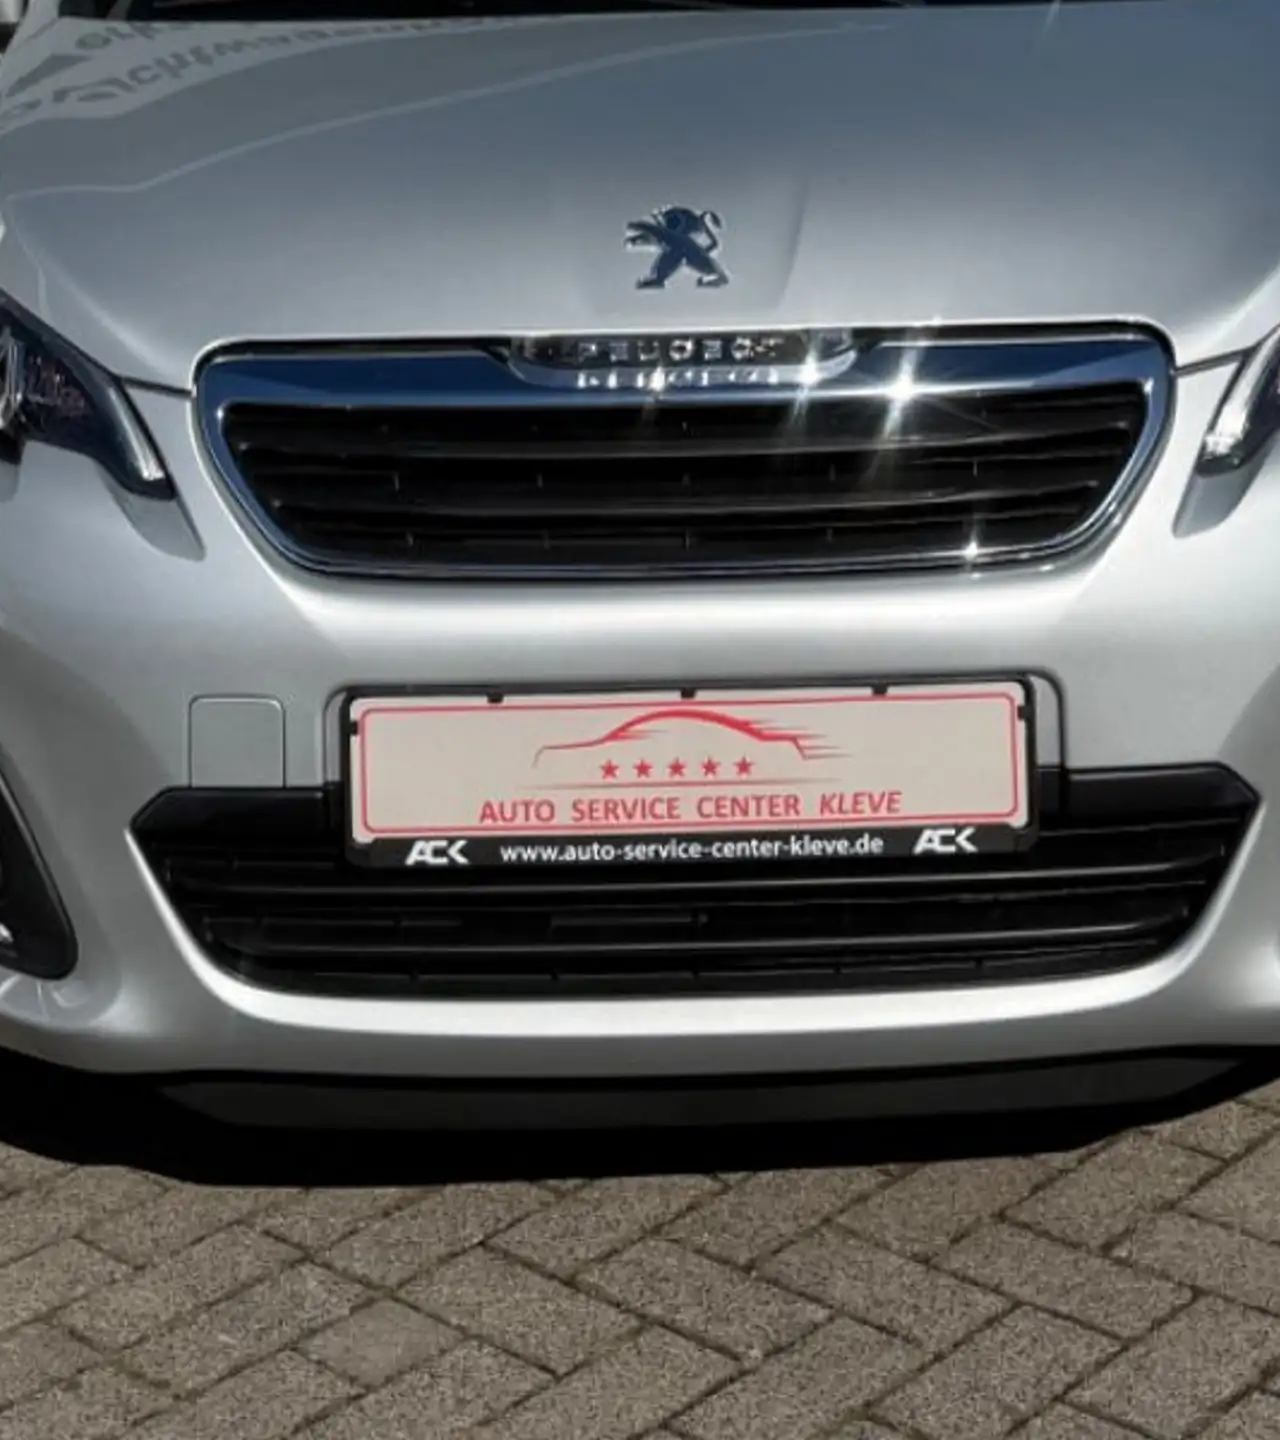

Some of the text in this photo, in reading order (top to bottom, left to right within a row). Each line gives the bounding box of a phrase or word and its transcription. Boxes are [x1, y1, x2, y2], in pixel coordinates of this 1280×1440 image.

[479, 790, 903, 824] AUTO SERVICE CENTER KLEVE
[499, 833, 885, 864] www.auto-service-center-kleve.de
